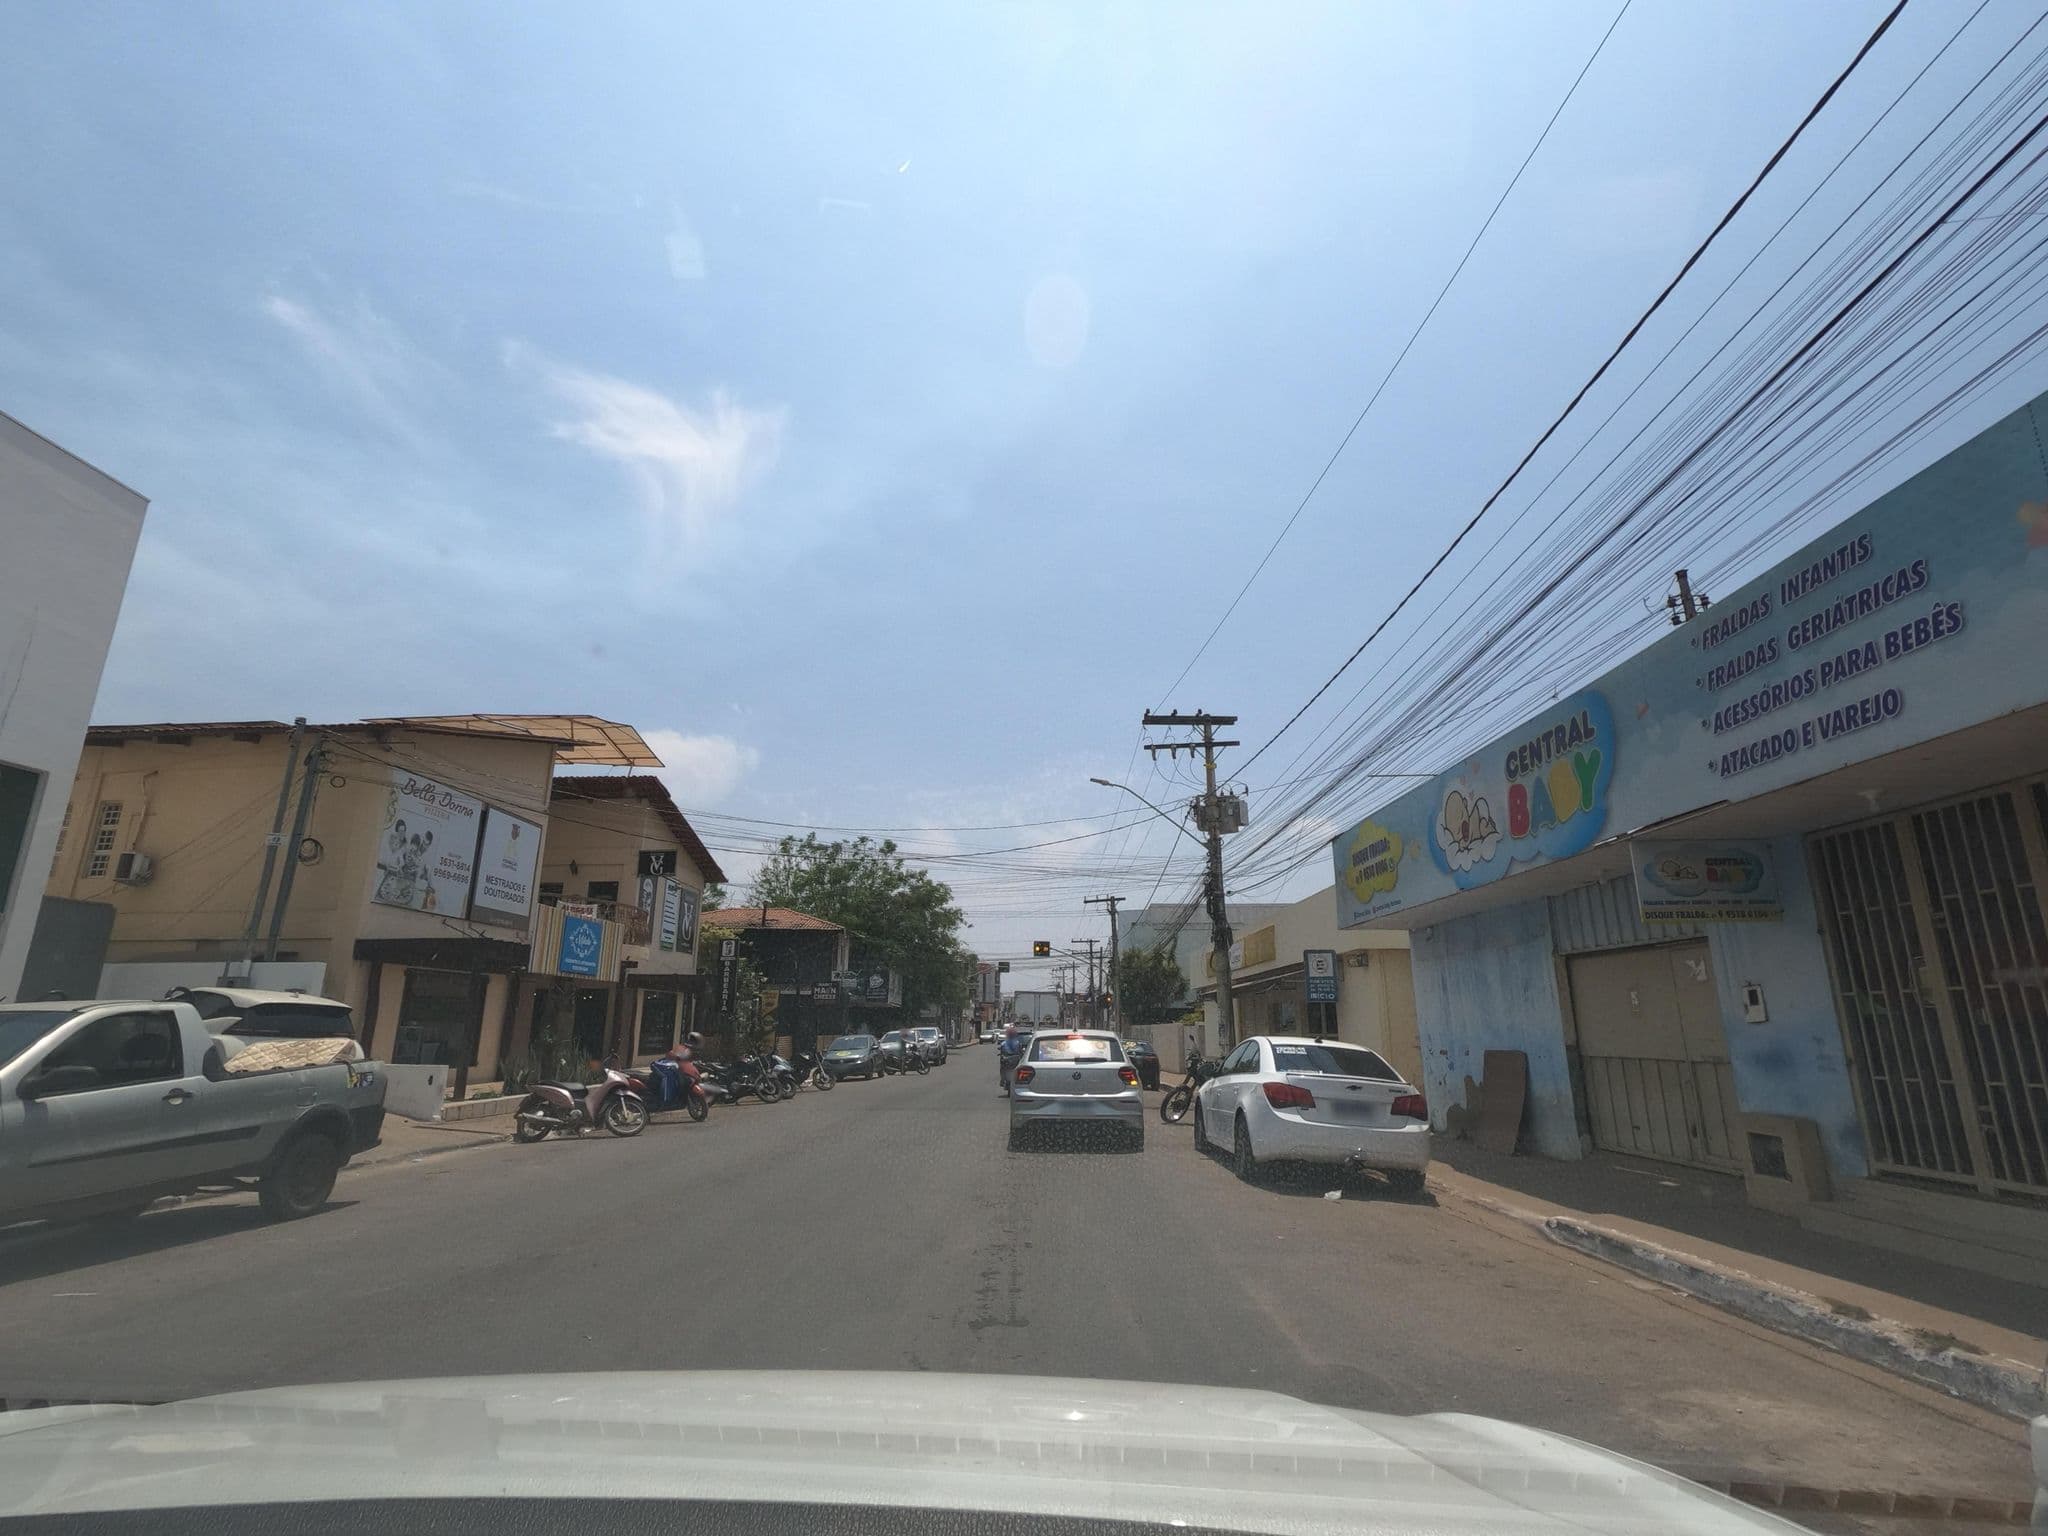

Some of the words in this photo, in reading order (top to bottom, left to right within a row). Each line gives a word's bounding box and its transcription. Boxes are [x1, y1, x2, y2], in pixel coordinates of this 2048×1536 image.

[1701, 592, 1771, 650] FRALDAS
[1780, 533, 1872, 606] INFANTIS
[1707, 637, 1778, 691] FRALDAS
[1787, 558, 1927, 651] GERIÁTRICAS
[1713, 668, 1815, 735] ACESSÓRIOS
[1820, 640, 1880, 688] PARA
[1884, 602, 1963, 660] BEBÊS
[1505, 710, 1595, 782] CENTRAL
[1720, 728, 1797, 777] ATACADO
[1801, 722, 1813, 746] E
[1817, 688, 1902, 740] VAREJO
[400, 777, 436, 805] Bella
[439, 792, 474, 818] Donna
[1508, 749, 1602, 838] BABY
[483, 886, 526, 905] DOUTORADOS
[485, 874, 522, 893] MESTRADOS
[1645, 910, 1673, 919] DISQUE
